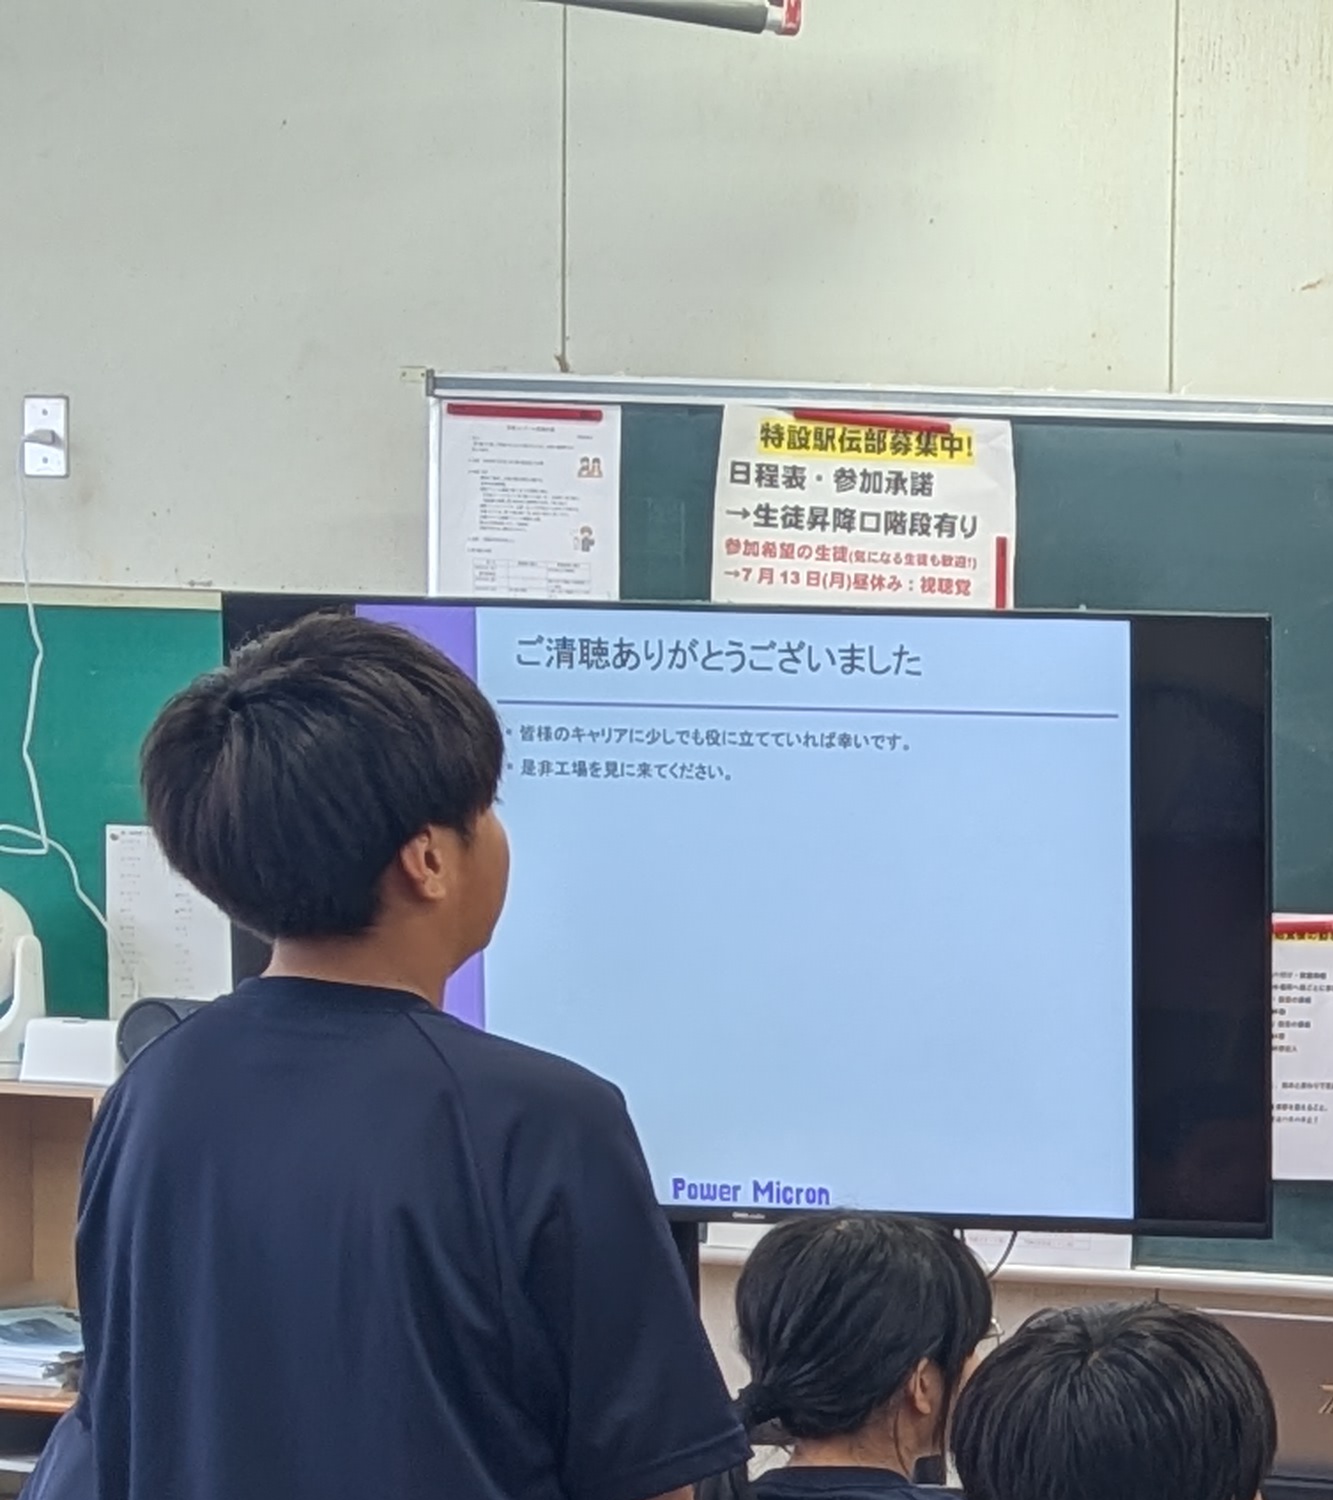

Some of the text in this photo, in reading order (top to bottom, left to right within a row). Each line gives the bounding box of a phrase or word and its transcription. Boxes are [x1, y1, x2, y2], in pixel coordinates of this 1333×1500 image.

[729, 461, 936, 498] 日程表・参加承諾
[514, 634, 923, 679] ご清聴ありがとうございました
[519, 726, 911, 752] 皆様のキャリアに少しでも役に立てていれば幸いです。
[520, 757, 733, 781] 是非工場を見に来てください。
[672, 1177, 831, 1206] Power Micron
